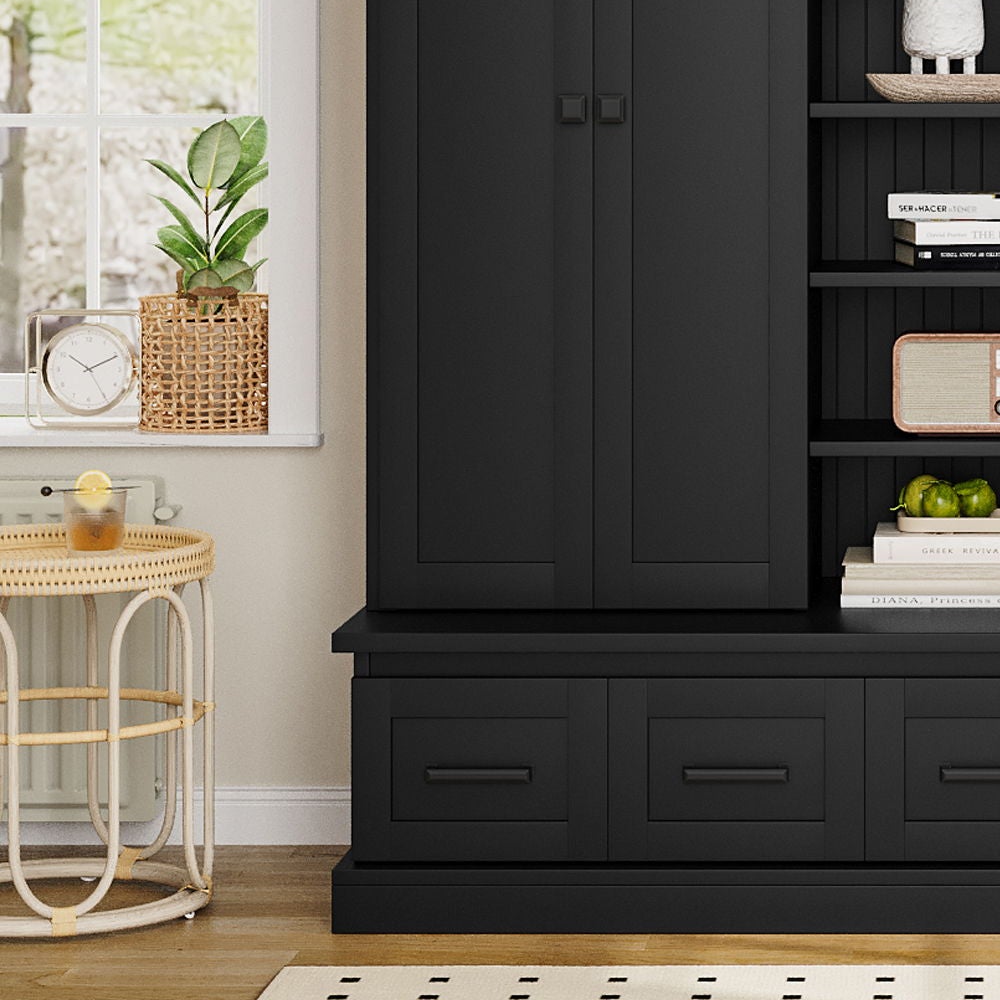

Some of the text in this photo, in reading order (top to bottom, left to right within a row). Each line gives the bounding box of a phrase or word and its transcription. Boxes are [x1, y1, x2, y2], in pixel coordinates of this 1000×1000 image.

[972, 230, 996, 240] THE
[922, 547, 954, 555] GREEK
[871, 596, 924, 605] DIANA,
[930, 596, 990, 605] Princess
